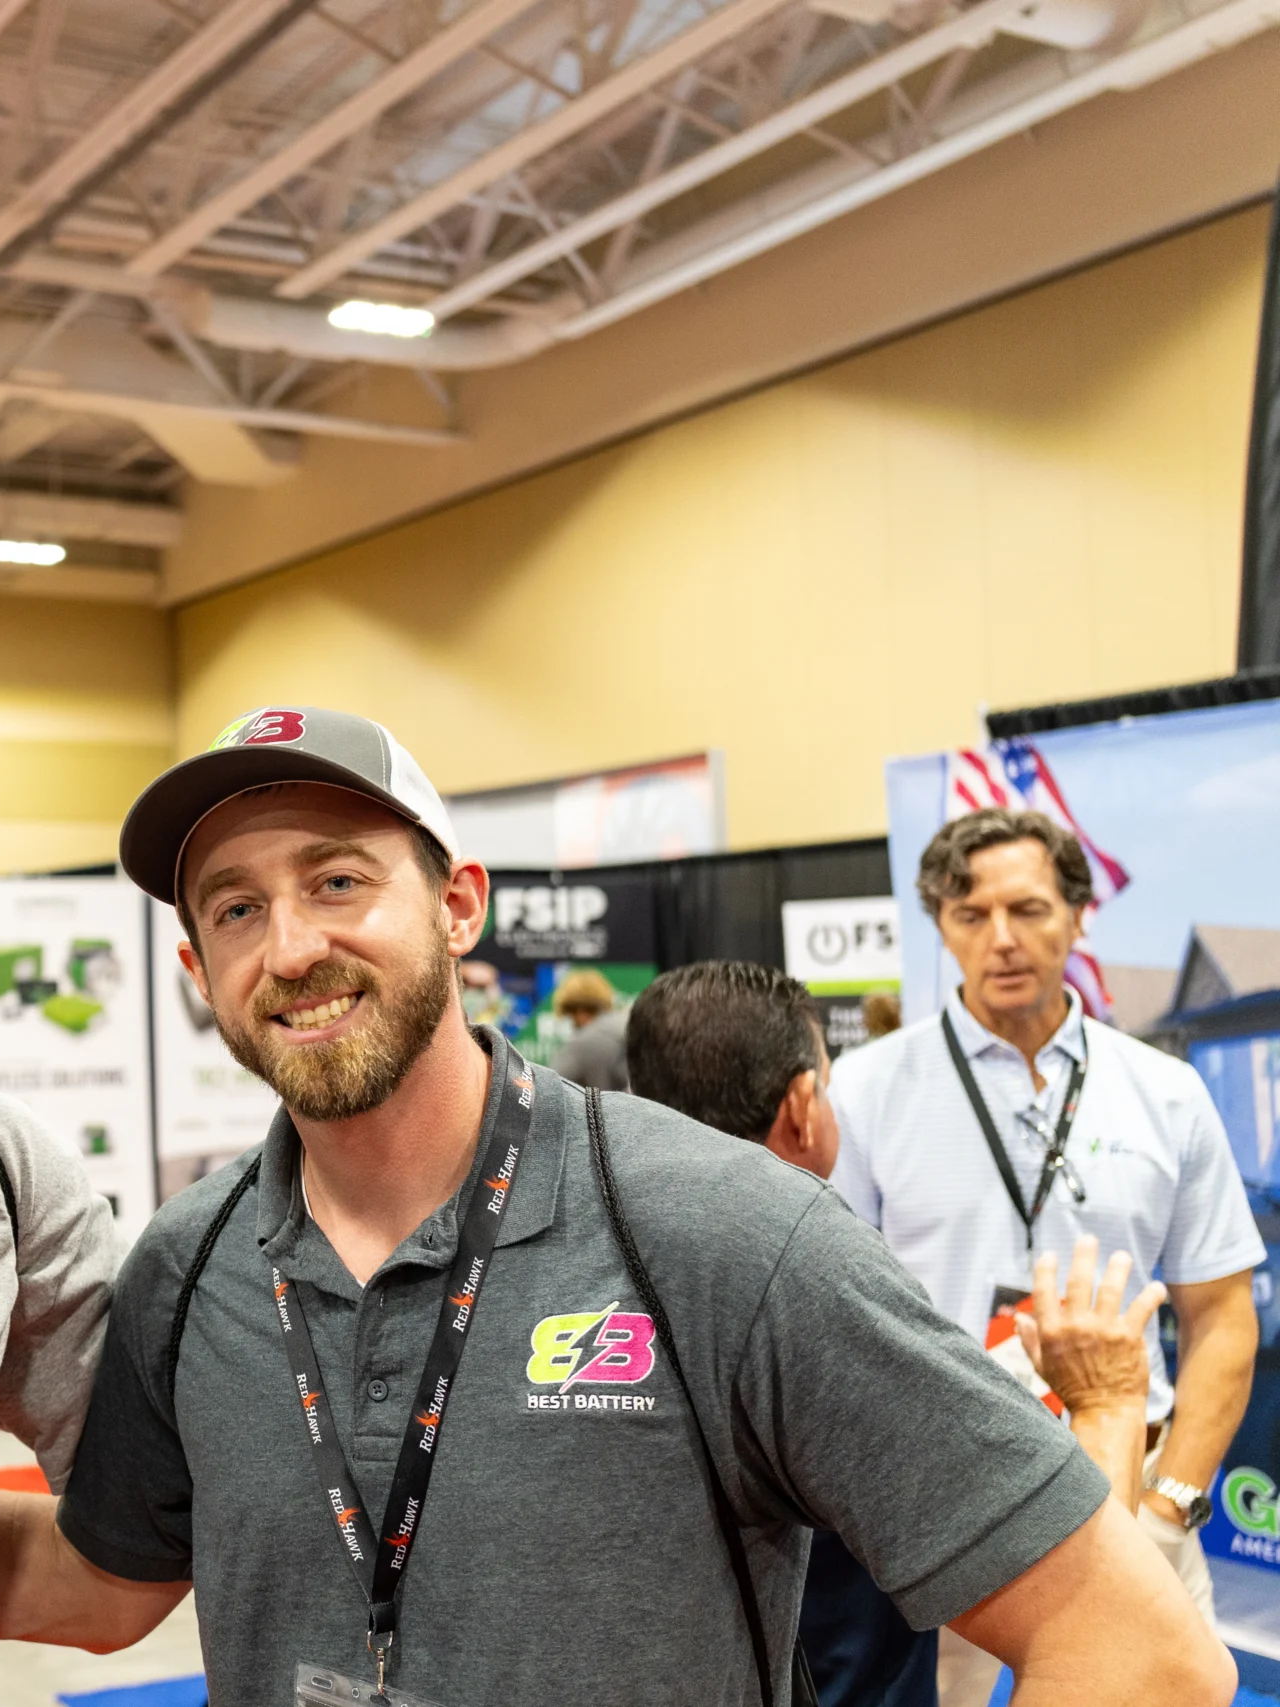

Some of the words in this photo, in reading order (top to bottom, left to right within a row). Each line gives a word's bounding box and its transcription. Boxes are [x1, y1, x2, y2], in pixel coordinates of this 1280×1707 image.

[495, 886, 608, 931] FSIP
[518, 1087, 532, 1110] RED
[487, 1188, 505, 1215] RED
[497, 1143, 519, 1183] HAWK
[276, 1295, 292, 1333] HAWK
[452, 1305, 470, 1333] RED
[462, 1256, 485, 1298] HAWK
[296, 1373, 309, 1399] RED
[305, 1405, 322, 1445] HAWK
[419, 1424, 436, 1454] RED
[428, 1375, 449, 1417] HAWK
[527, 1394, 570, 1409] BEST
[575, 1394, 655, 1411] BATTERY
[328, 1487, 345, 1515] RED
[338, 1521, 364, 1562] HAWK
[398, 1496, 419, 1538] HAWK
[391, 1543, 407, 1570] RED
